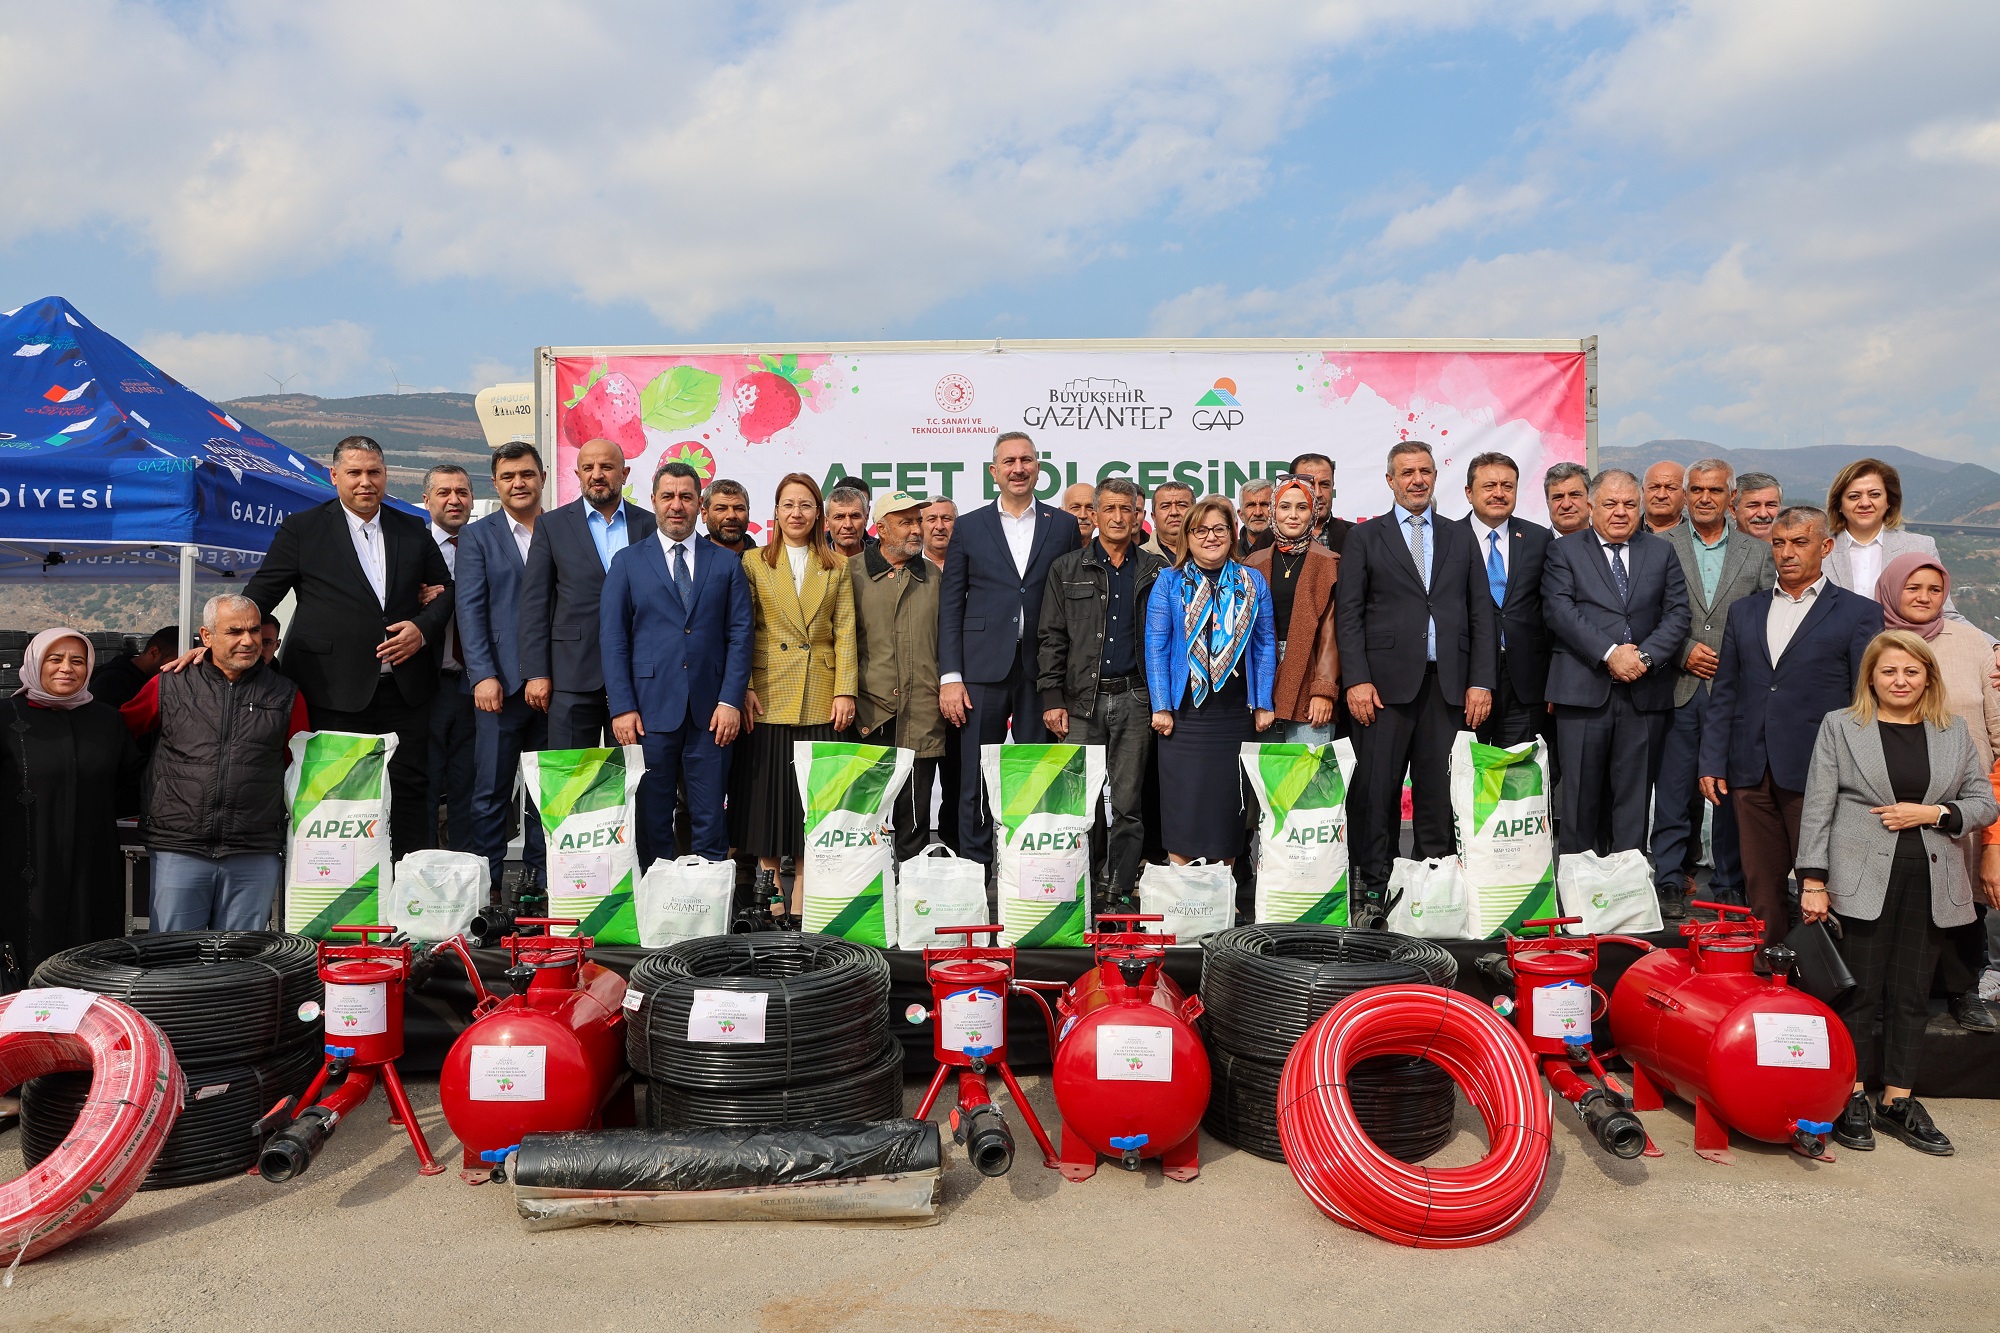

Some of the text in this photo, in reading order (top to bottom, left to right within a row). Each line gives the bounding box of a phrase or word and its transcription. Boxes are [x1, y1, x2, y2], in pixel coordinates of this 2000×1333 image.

[1048, 388, 1147, 406] BÜYÜKŞEHİR
[515, 404, 532, 415] 420
[1023, 403, 1173, 431] GAZİANTEP
[912, 425, 999, 435] TEKNOLOJİ BAKANLIĞI
[926, 418, 939, 426] T.C.
[941, 417, 970, 426] SANAYİ
[1192, 410, 1244, 431] GAP
[821, 461, 964, 501] AFET
[231, 501, 291, 527] GAZİA
[306, 820, 373, 839] APEX
[1287, 825, 1342, 846] APEX
[1493, 816, 1545, 838] APEX
[560, 826, 621, 850] APEX
[814, 829, 873, 848] APEX
[1020, 832, 1081, 851] APEX
